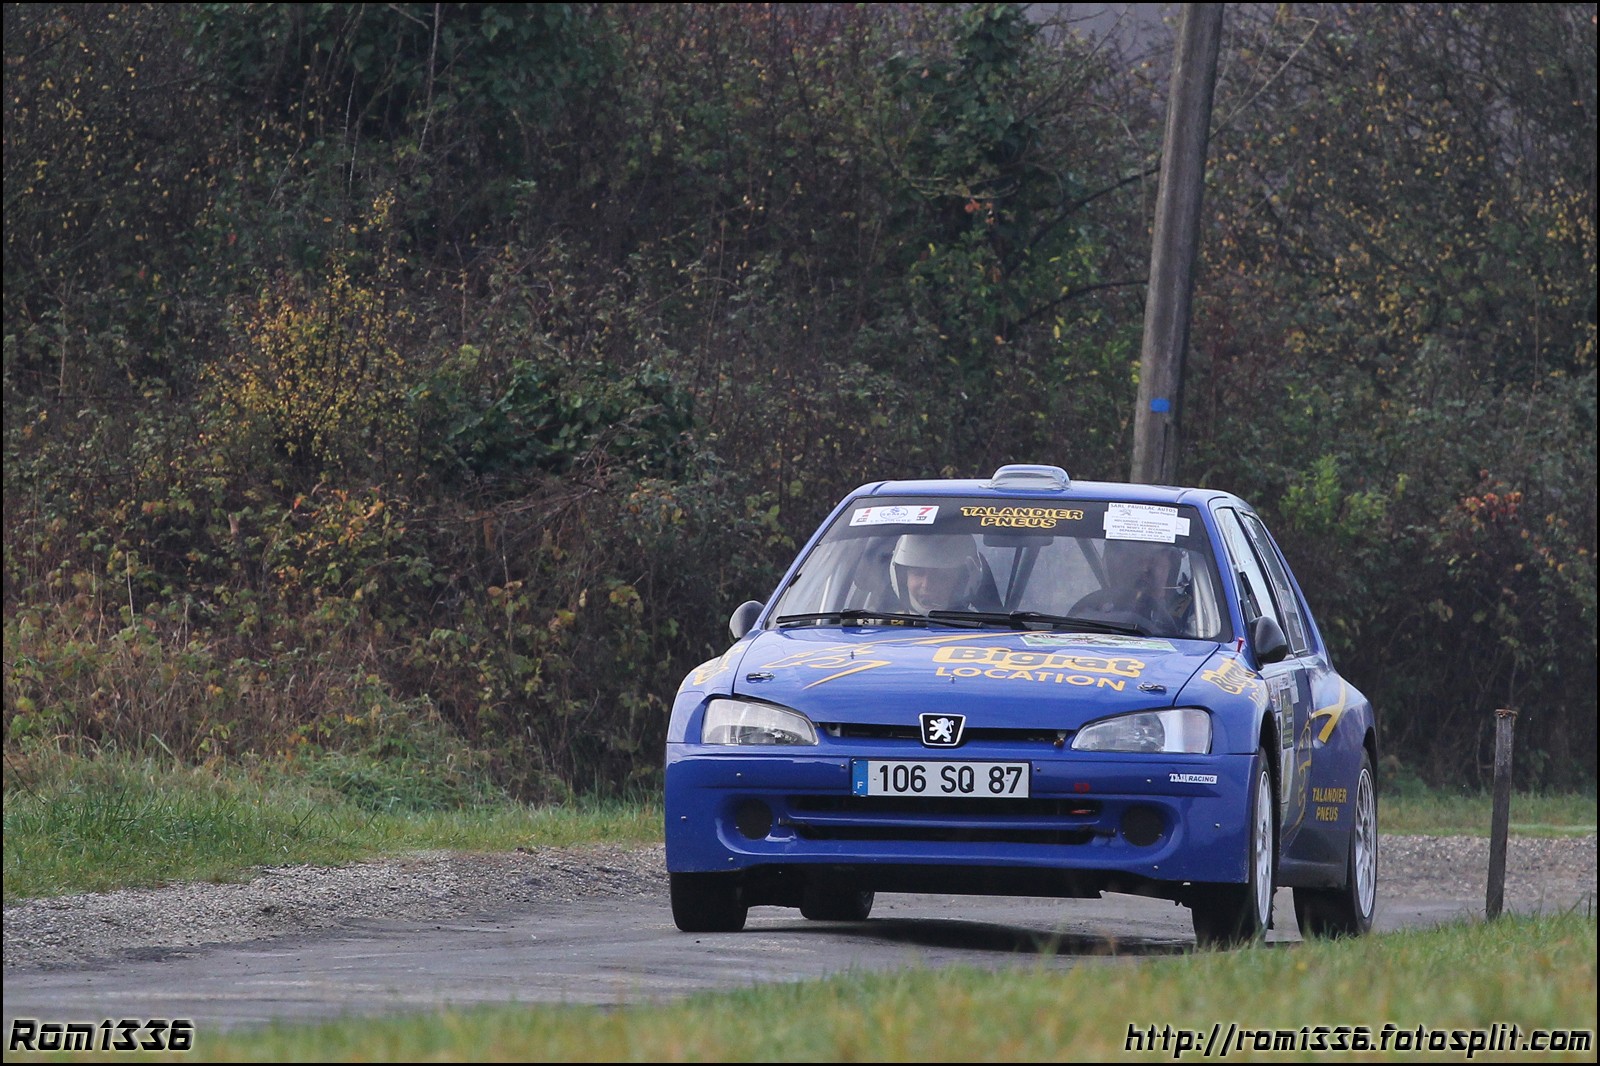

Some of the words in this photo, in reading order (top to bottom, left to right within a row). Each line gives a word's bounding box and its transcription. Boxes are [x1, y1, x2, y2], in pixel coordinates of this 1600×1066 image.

[961, 506, 1084, 519] TALANDIER
[981, 517, 1057, 528] PNEUS
[933, 646, 1145, 677] Bigrat
[936, 666, 1126, 692] LOCATION
[879, 764, 927, 793] 106
[940, 765, 975, 793] SQ
[988, 765, 1023, 794] 87
[1188, 775, 1215, 783] RACING
[1312, 787, 1347, 803] TALANDIER
[1315, 806, 1339, 822] PNEUS
